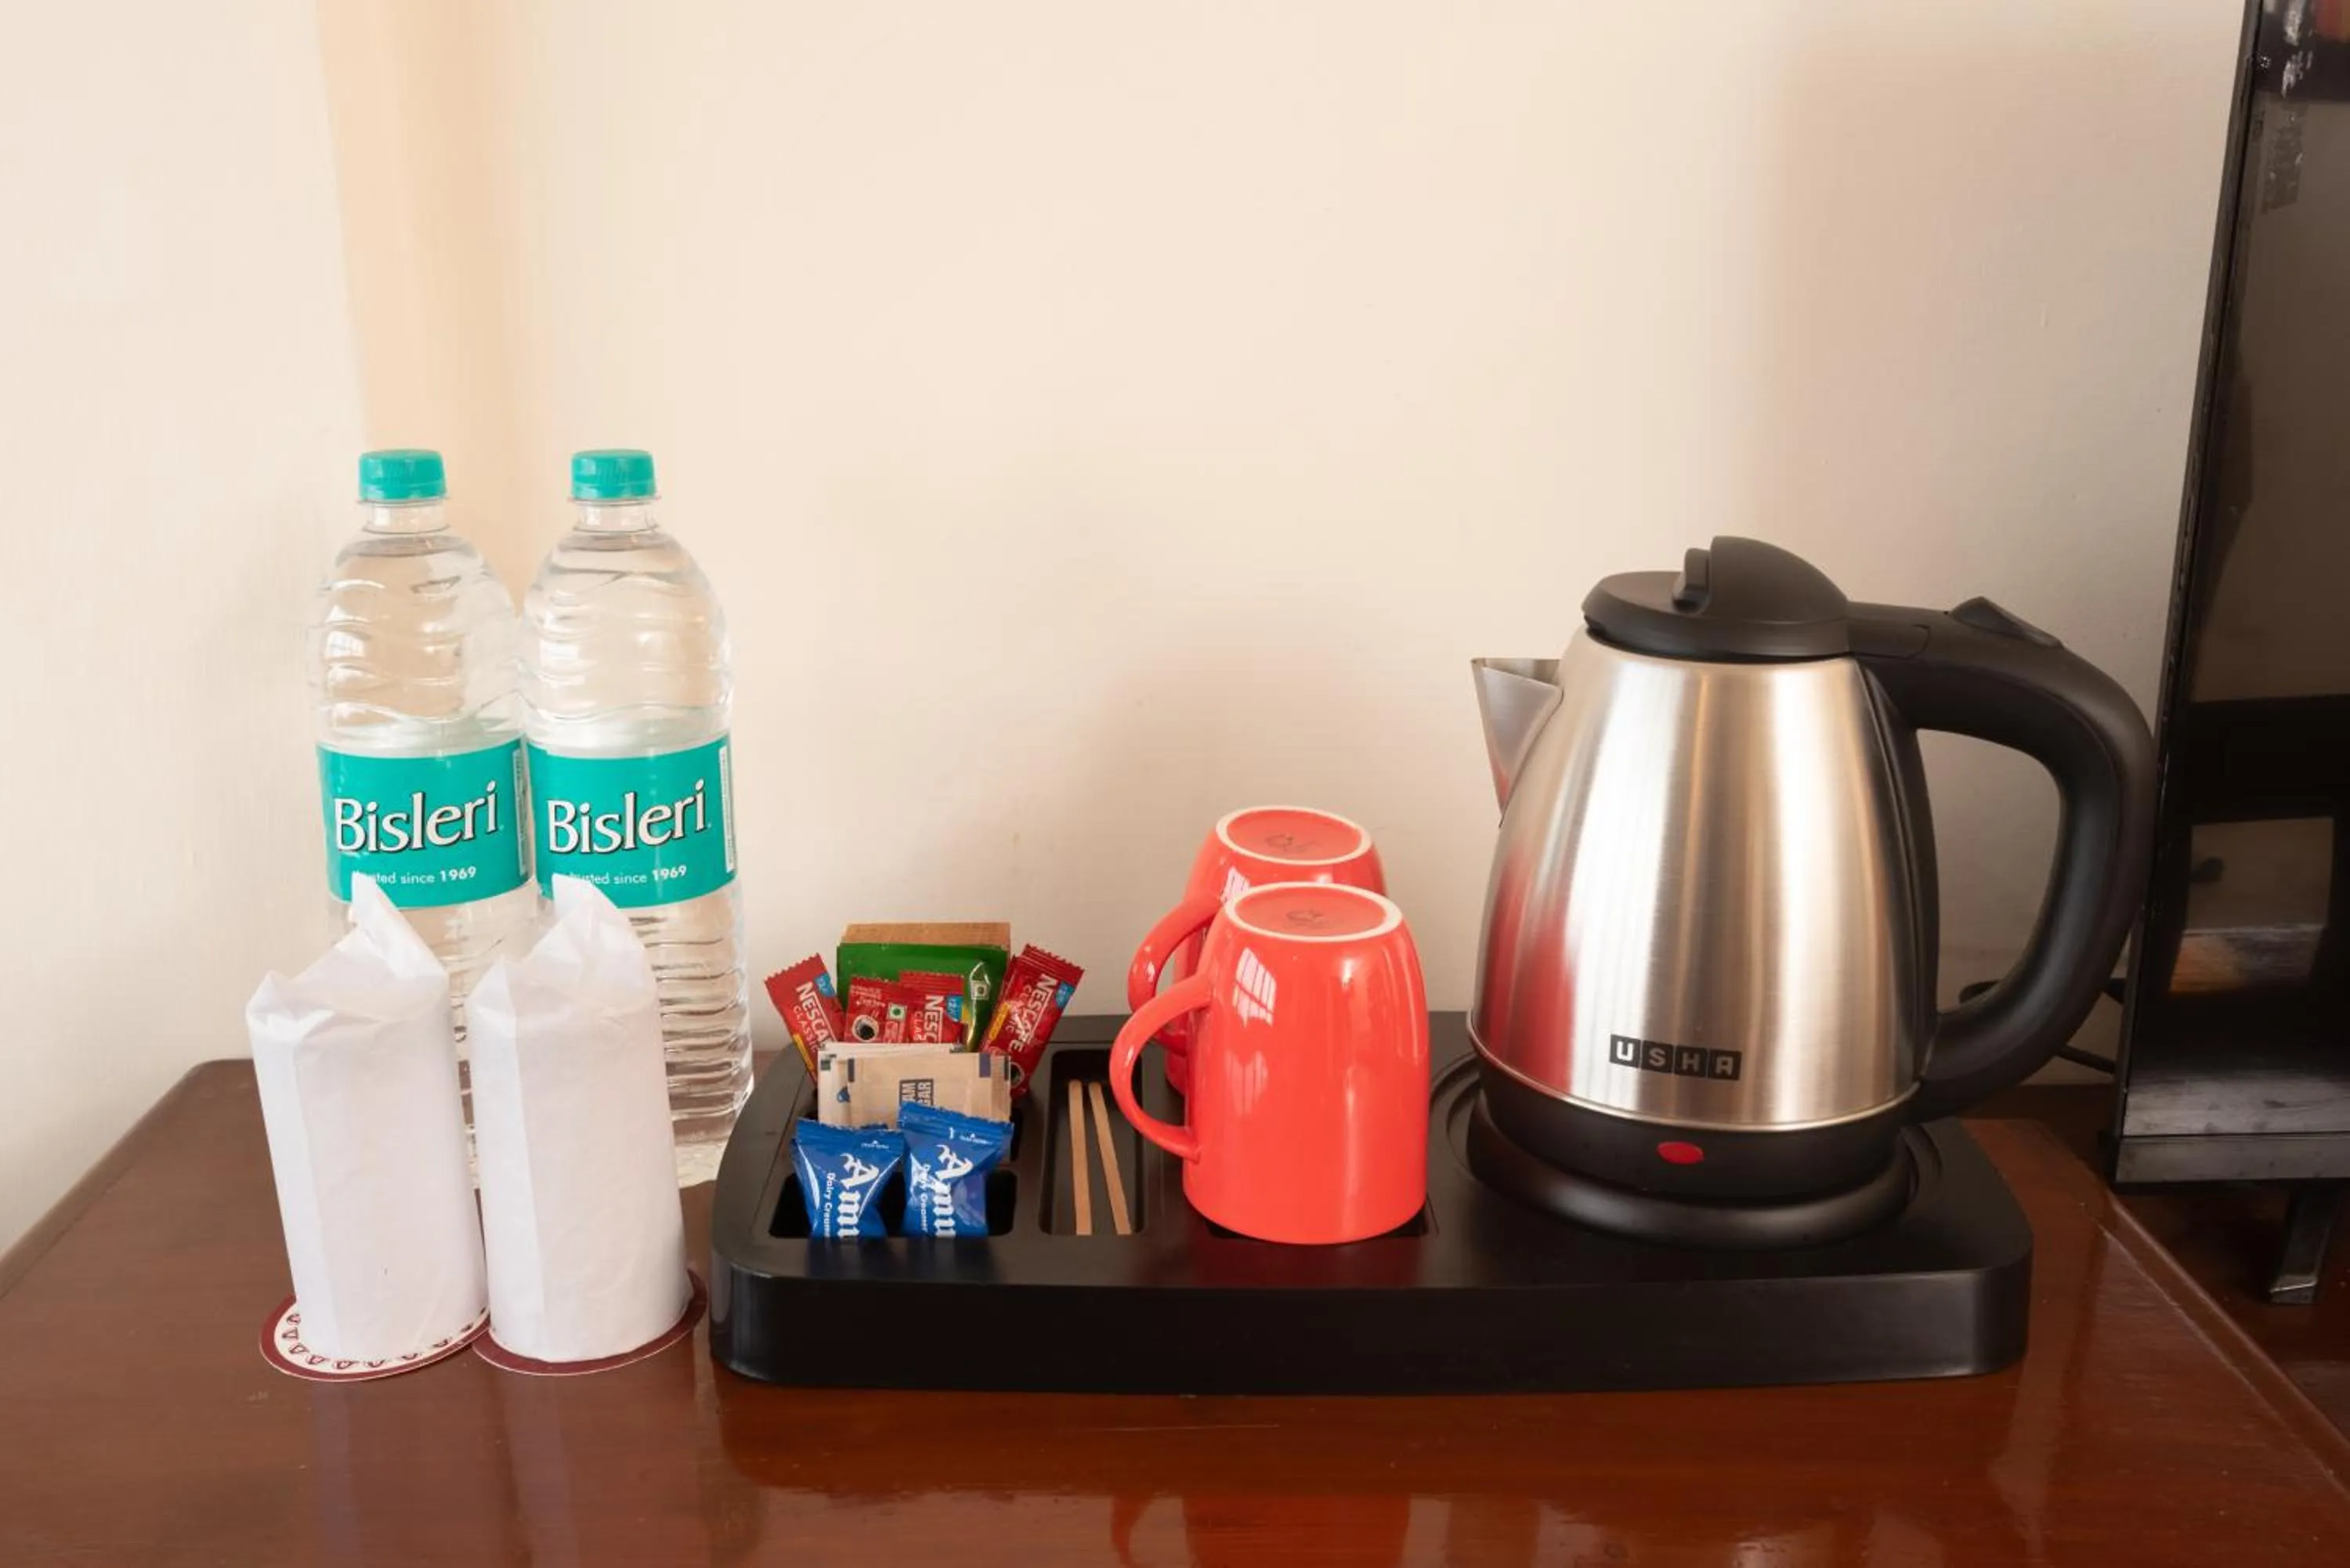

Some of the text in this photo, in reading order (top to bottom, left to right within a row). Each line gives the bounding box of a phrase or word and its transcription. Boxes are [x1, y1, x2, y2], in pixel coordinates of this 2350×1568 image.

[334, 779, 497, 854] Bisleri
[548, 779, 707, 854] Bisleri
[400, 872, 436, 884] since
[439, 865, 477, 882] 1969
[613, 873, 648, 885] since
[652, 864, 687, 881] 1969
[795, 981, 837, 1045] NESCA
[914, 1010, 927, 1042] CLAS
[924, 994, 945, 1042] NESC
[1614, 1039, 1736, 1078] USHA
[824, 1172, 836, 1199] Dairy
[933, 1144, 974, 1237] Amu
